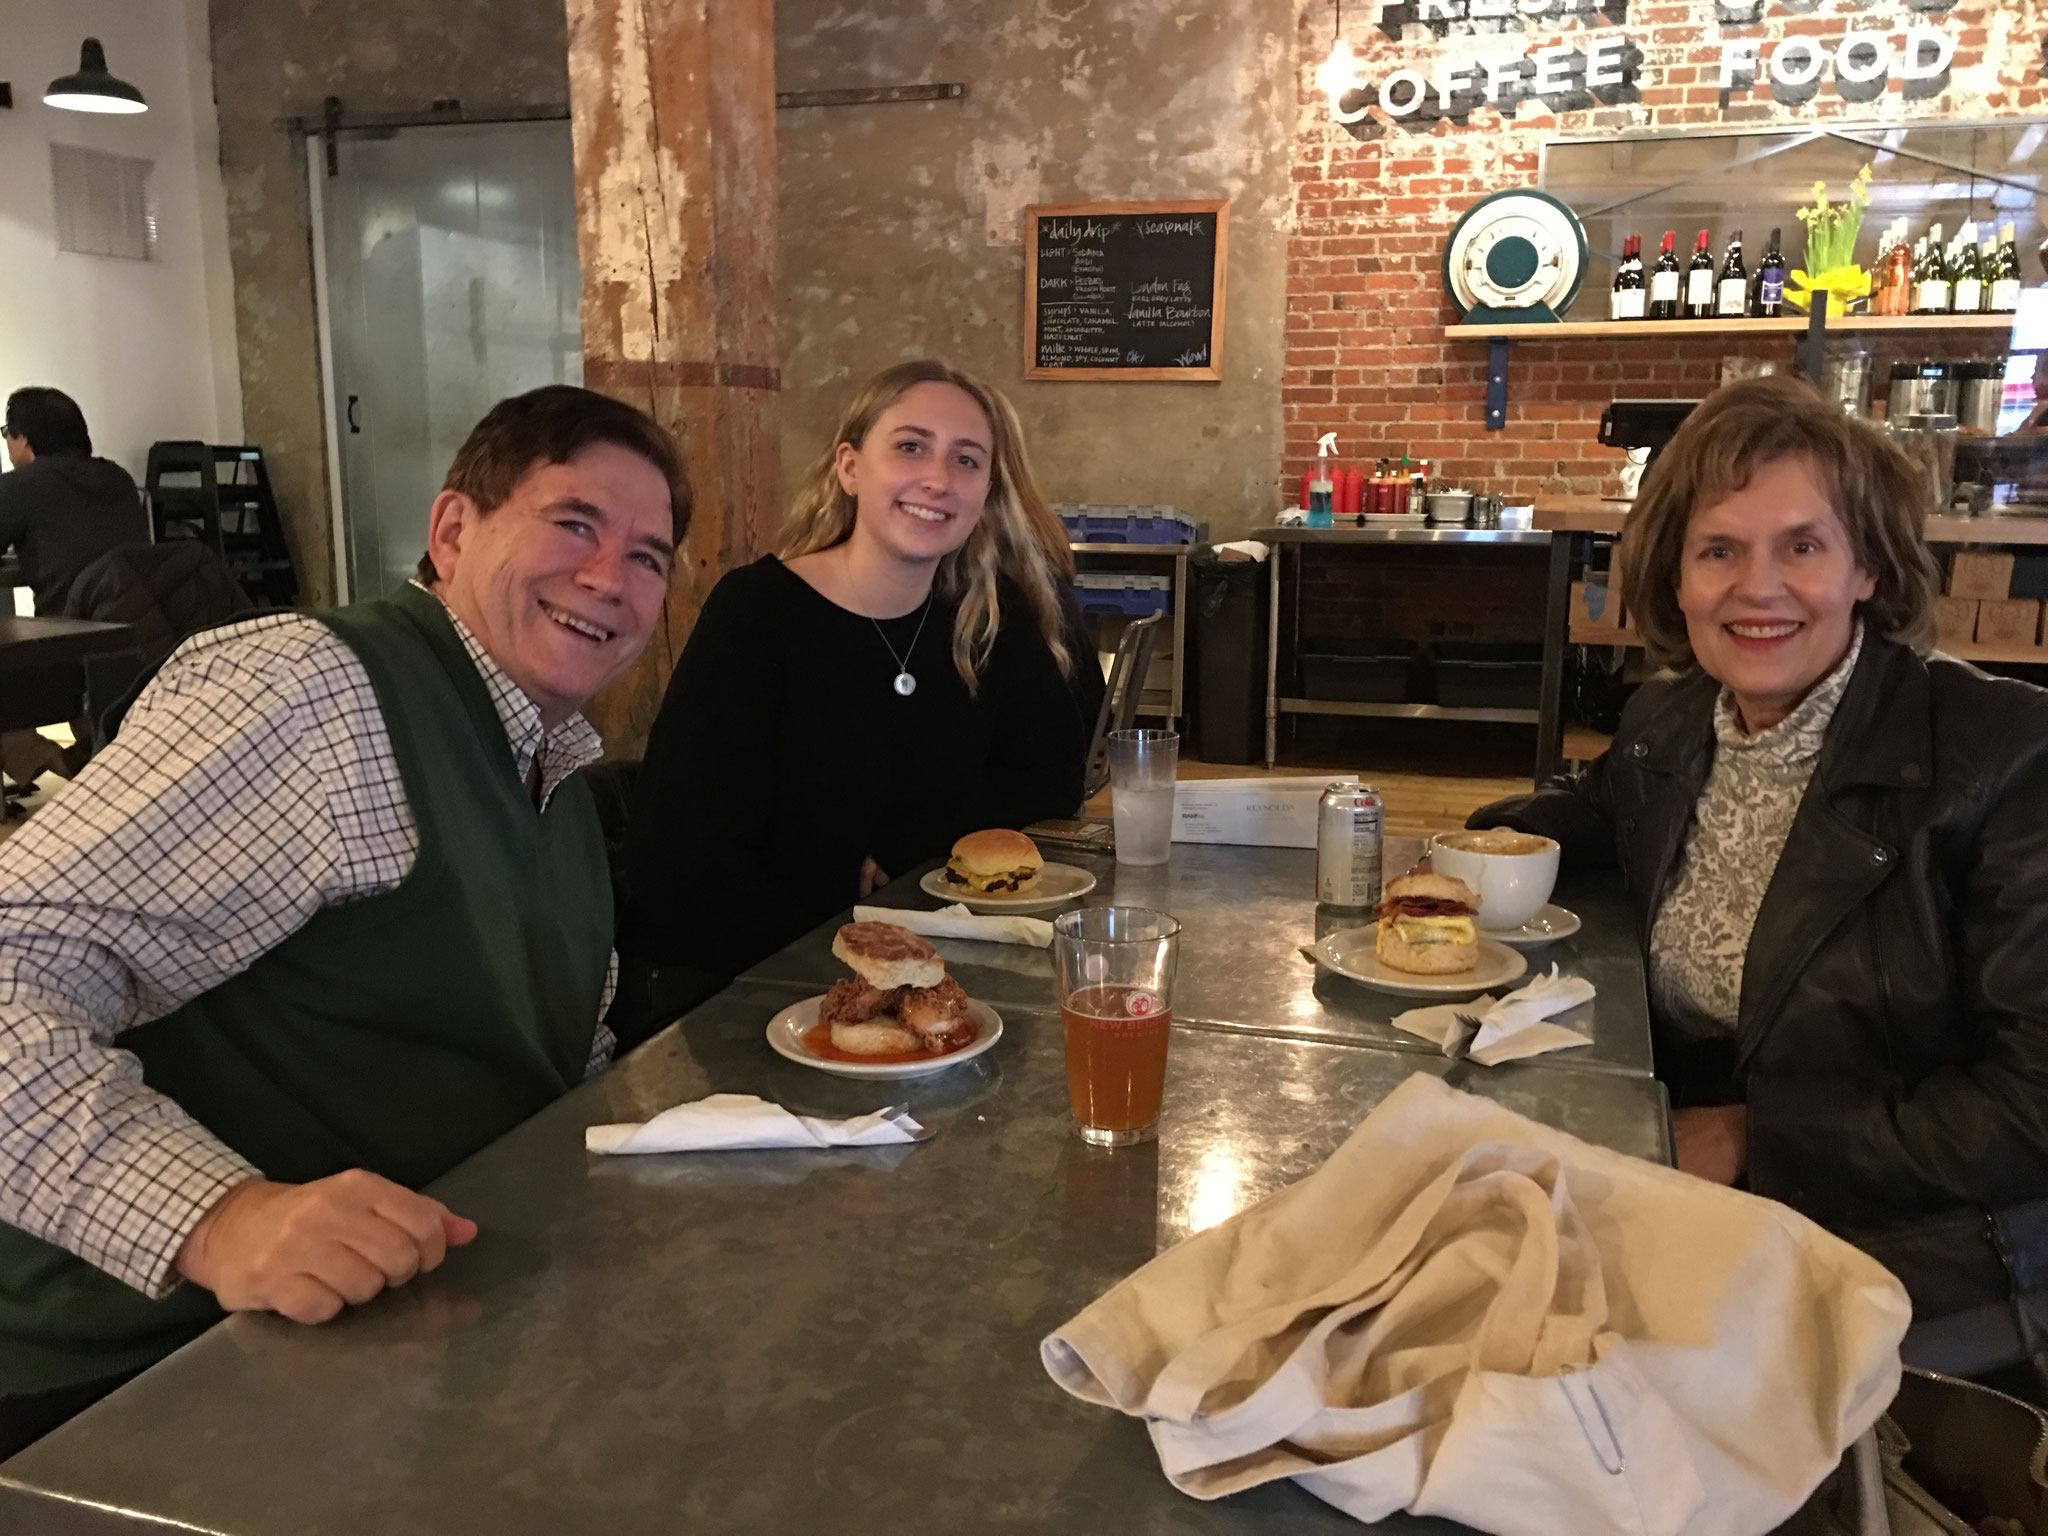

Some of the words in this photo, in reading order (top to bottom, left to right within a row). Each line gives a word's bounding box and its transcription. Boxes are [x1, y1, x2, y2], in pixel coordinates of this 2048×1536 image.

[1328, 35, 1629, 125] COFFEE
[1718, 23, 1958, 89] FOOD
[1049, 218, 1082, 247] daily
[1083, 218, 1111, 243] drip
[1145, 218, 1194, 236] seasonal
[1040, 247, 1066, 258] LIGHT
[1040, 277, 1068, 289] DARK
[1165, 304, 1211, 320] Bourbon
